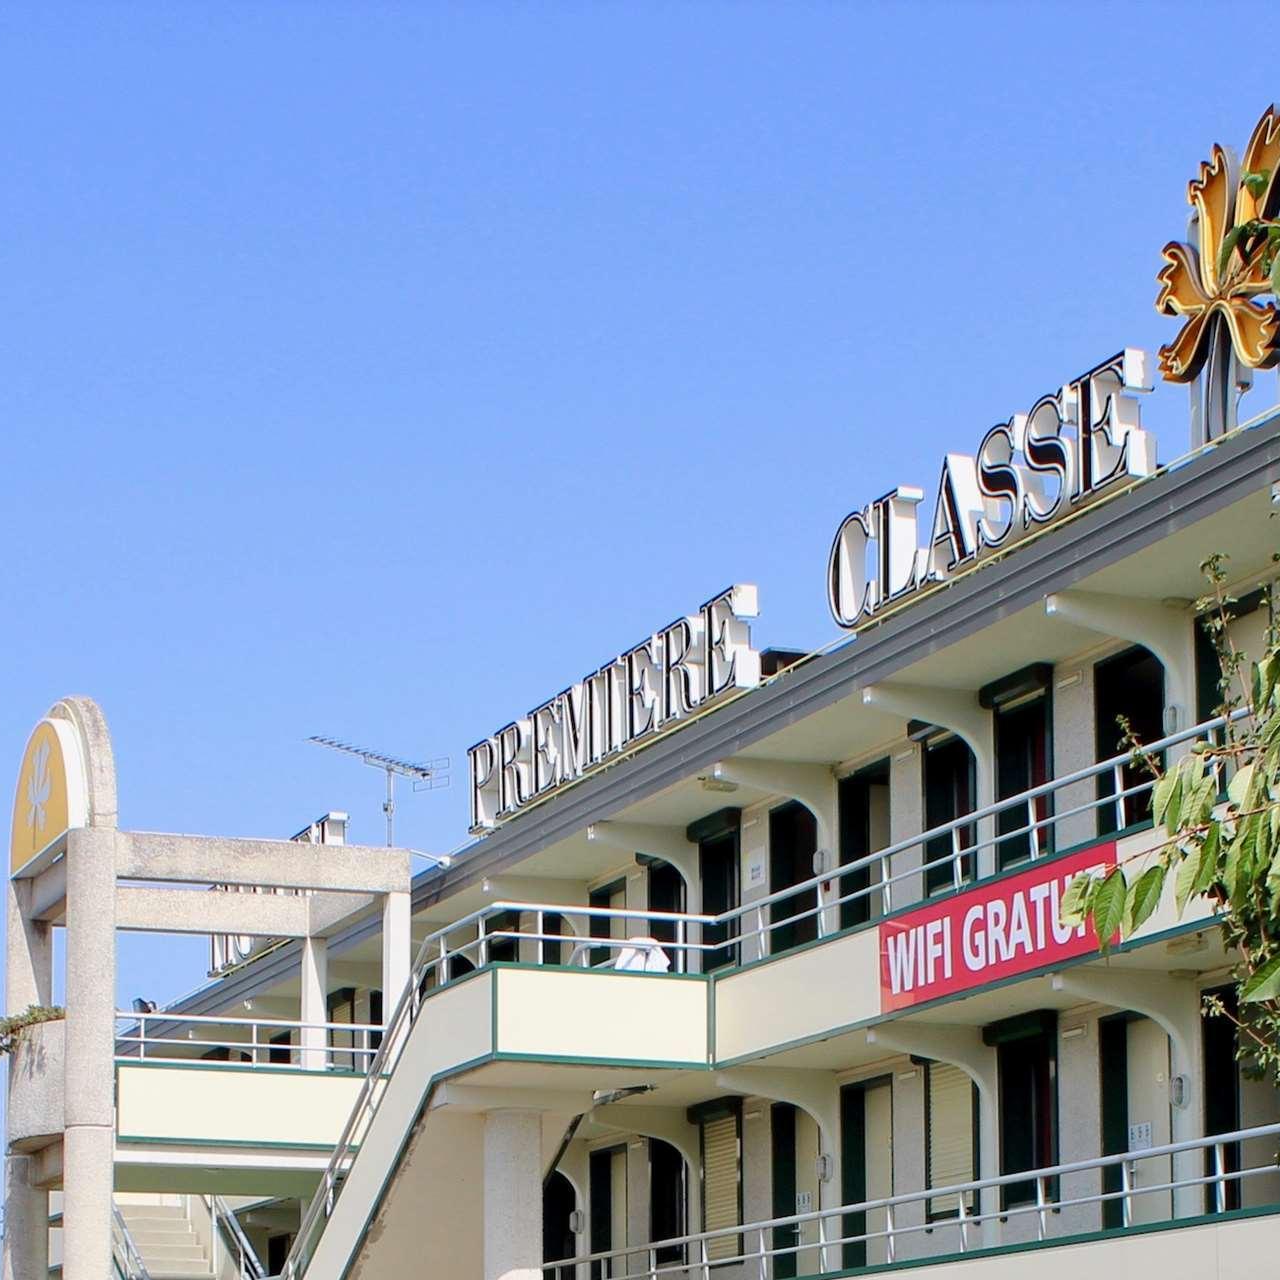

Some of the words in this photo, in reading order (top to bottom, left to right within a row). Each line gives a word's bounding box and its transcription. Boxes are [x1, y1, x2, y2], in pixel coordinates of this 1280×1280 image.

[468, 585, 760, 836] PREMIERE
[827, 348, 1156, 628] CLASSE
[887, 915, 953, 995] WIFI
